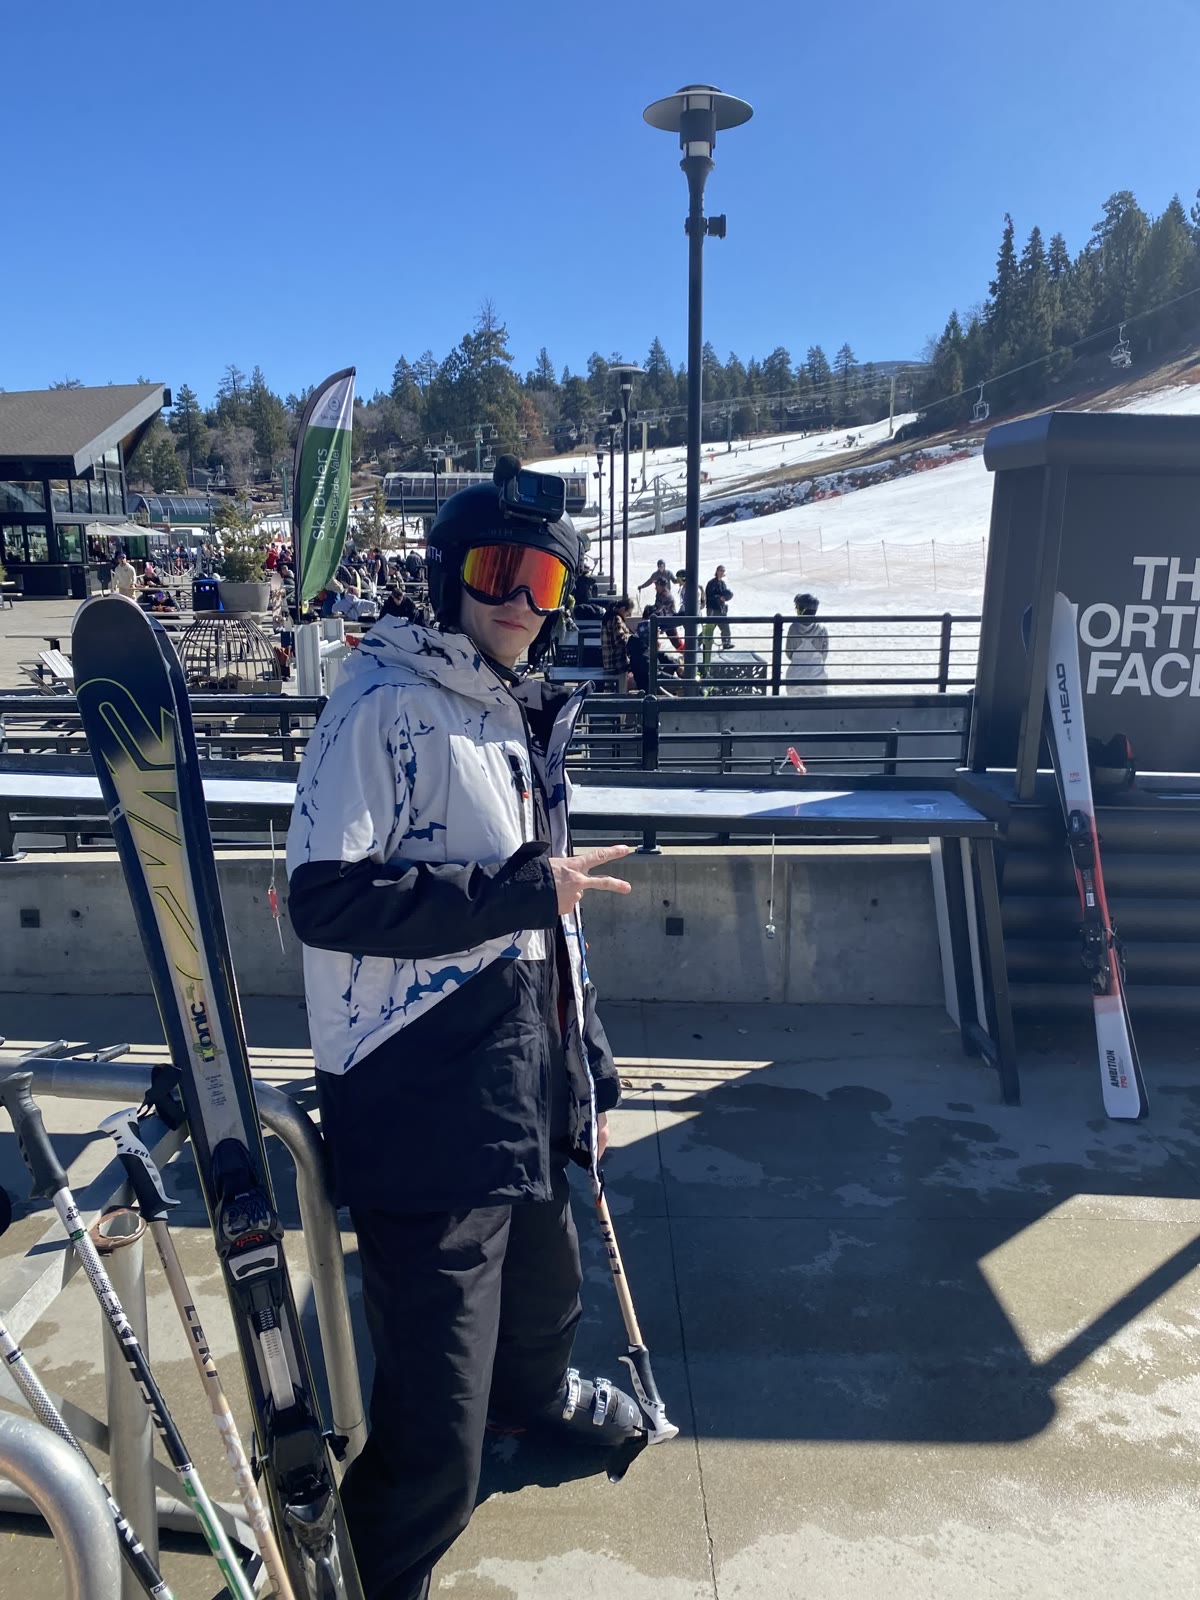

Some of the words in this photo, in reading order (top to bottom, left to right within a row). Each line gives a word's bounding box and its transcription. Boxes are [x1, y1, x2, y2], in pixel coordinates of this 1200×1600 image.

[312, 448, 328, 507] Butlers
[329, 476, 340, 528] Slopeside
[311, 517, 326, 541] Ski
[1071, 602, 1200, 649] ORT
[1056, 662, 1072, 725] HEAD
[1105, 1049, 1120, 1088] AMBITION
[126, 1147, 149, 1159] LEKI
[600, 1220, 621, 1275] LEKI
[93, 1271, 139, 1346] LEKI
[184, 1304, 218, 1378] LEKI
[641, 1397, 659, 1409] LEKI
[97, 1476, 145, 1556] EKI
